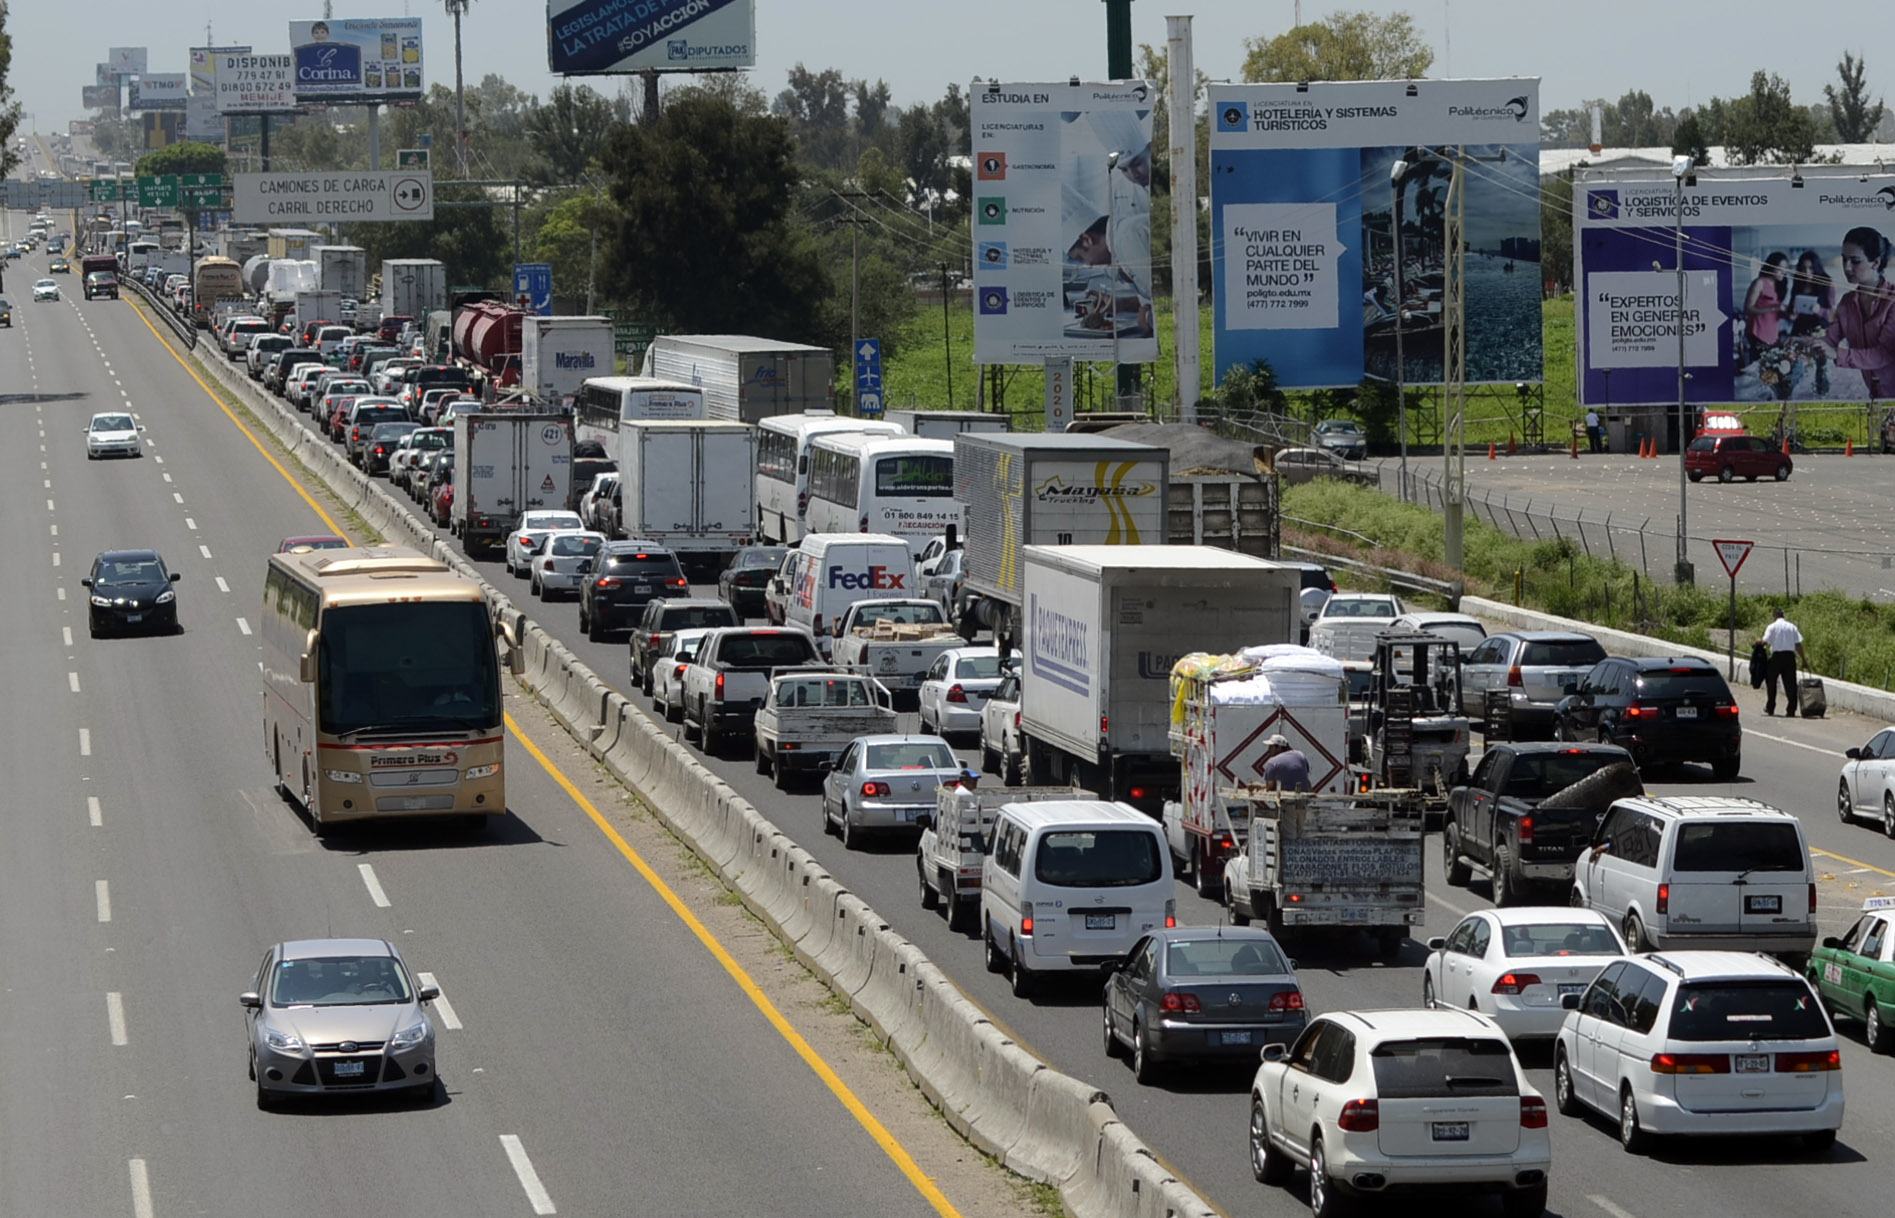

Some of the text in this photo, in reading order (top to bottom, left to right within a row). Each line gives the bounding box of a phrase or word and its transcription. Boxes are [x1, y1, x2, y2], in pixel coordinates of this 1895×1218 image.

[563, 0, 659, 56] LA TRATA DE
[688, 46, 748, 56] DIPUTADOS
[227, 57, 290, 69] DISPONIB
[299, 66, 353, 80] Corina
[982, 93, 1049, 104] ESTUDIA EN
[1254, 106, 1397, 119] HOTELERÍA Y SISTEMAS
[1449, 106, 1514, 116] Politécnico
[1254, 119, 1327, 131] TURÍSTICOS
[260, 178, 386, 194] CAMIONES DE CARGA
[1691, 196, 1709, 206] DE
[1712, 195, 1768, 206] EVENTOS
[1820, 195, 1885, 204] Politécnico
[268, 199, 374, 215] CARRIL DERECHO
[1625, 207, 1634, 217] Y
[1282, 230, 1301, 242] EN
[1246, 245, 1325, 257] CUALQUIER
[1246, 259, 1320, 271] PARTE DEL
[1246, 289, 1312, 298] poligto.edu.mx
[1246, 299, 1268, 309] (477)
[1270, 300, 1286, 308] 772
[1611, 311, 1629, 323] EN
[544, 428, 557, 439] 421
[949, 512, 960, 520] 15
[829, 565, 906, 590] FedEx
[417, 754, 441, 764] Plus
